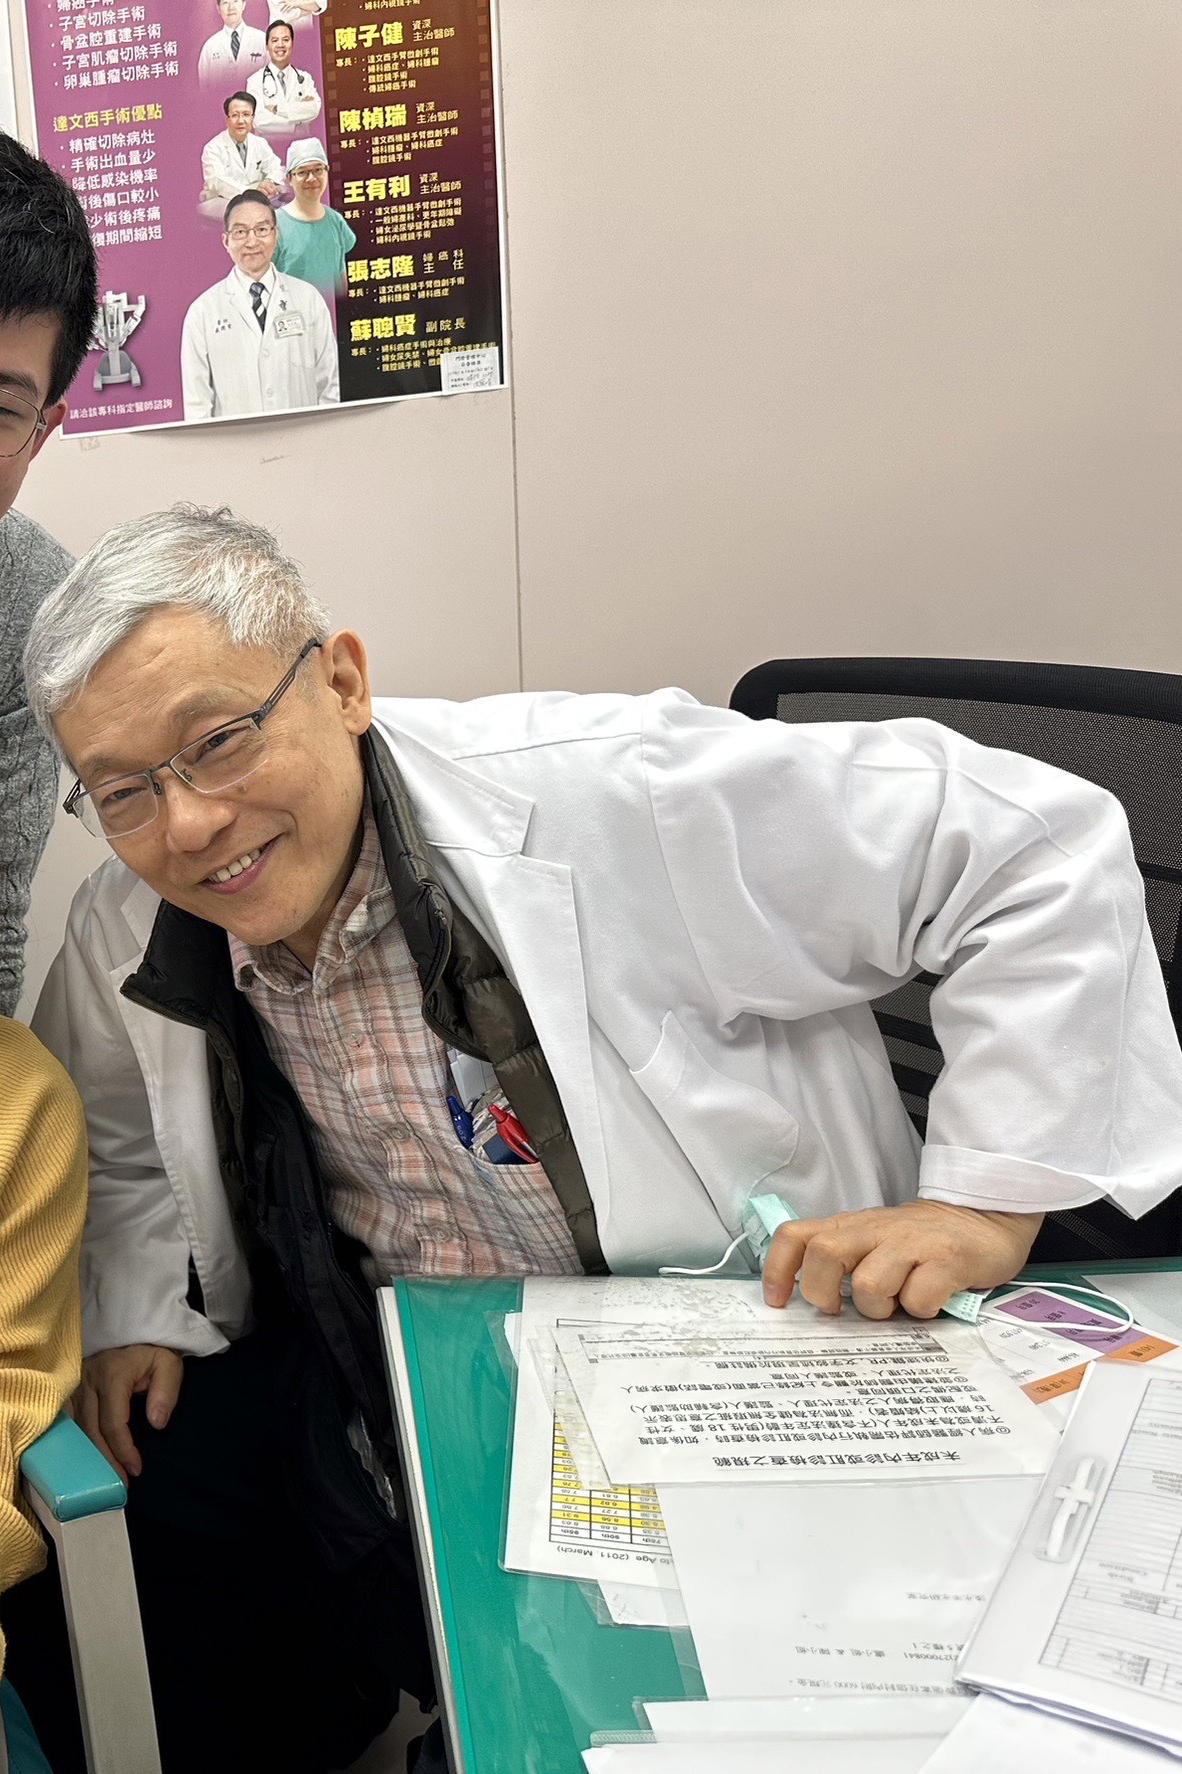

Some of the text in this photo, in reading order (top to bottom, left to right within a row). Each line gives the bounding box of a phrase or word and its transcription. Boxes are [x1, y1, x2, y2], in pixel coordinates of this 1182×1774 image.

[59, 6, 146, 32] 子宮切除手術
[60, 23, 162, 52] 骨盆腔重建手術
[335, 18, 431, 51] 陳子健 資深
[413, 27, 455, 42] 主治醫師
[62, 41, 178, 72] 子宮肌瘤切除手術
[63, 61, 179, 91] 卵巢腫瘤切除手術
[53, 103, 163, 133] 達文西手術優點
[416, 101, 435, 114] 資深
[417, 110, 459, 125] 主治醫師
[69, 129, 155, 154] 精確切除病灶
[70, 148, 156, 173] 手術出血量少
[71, 168, 159, 192] 降低感染機率
[344, 172, 438, 204] 王有利 資深
[420, 181, 462, 195] 主治醫師
[84, 206, 161, 229] 少術後疼痛
[348, 254, 415, 283] 張志隆
[350, 314, 466, 342] 蘇聰賢 副院長
[974, 1404, 995, 1413] 16
[707, 1423, 726, 1432] 18
[711, 1451, 961, 1467] 未成年內診或肛診檢查之規範
[557, 1545, 594, 1556] March)
[635, 1555, 656, 1564] Age
